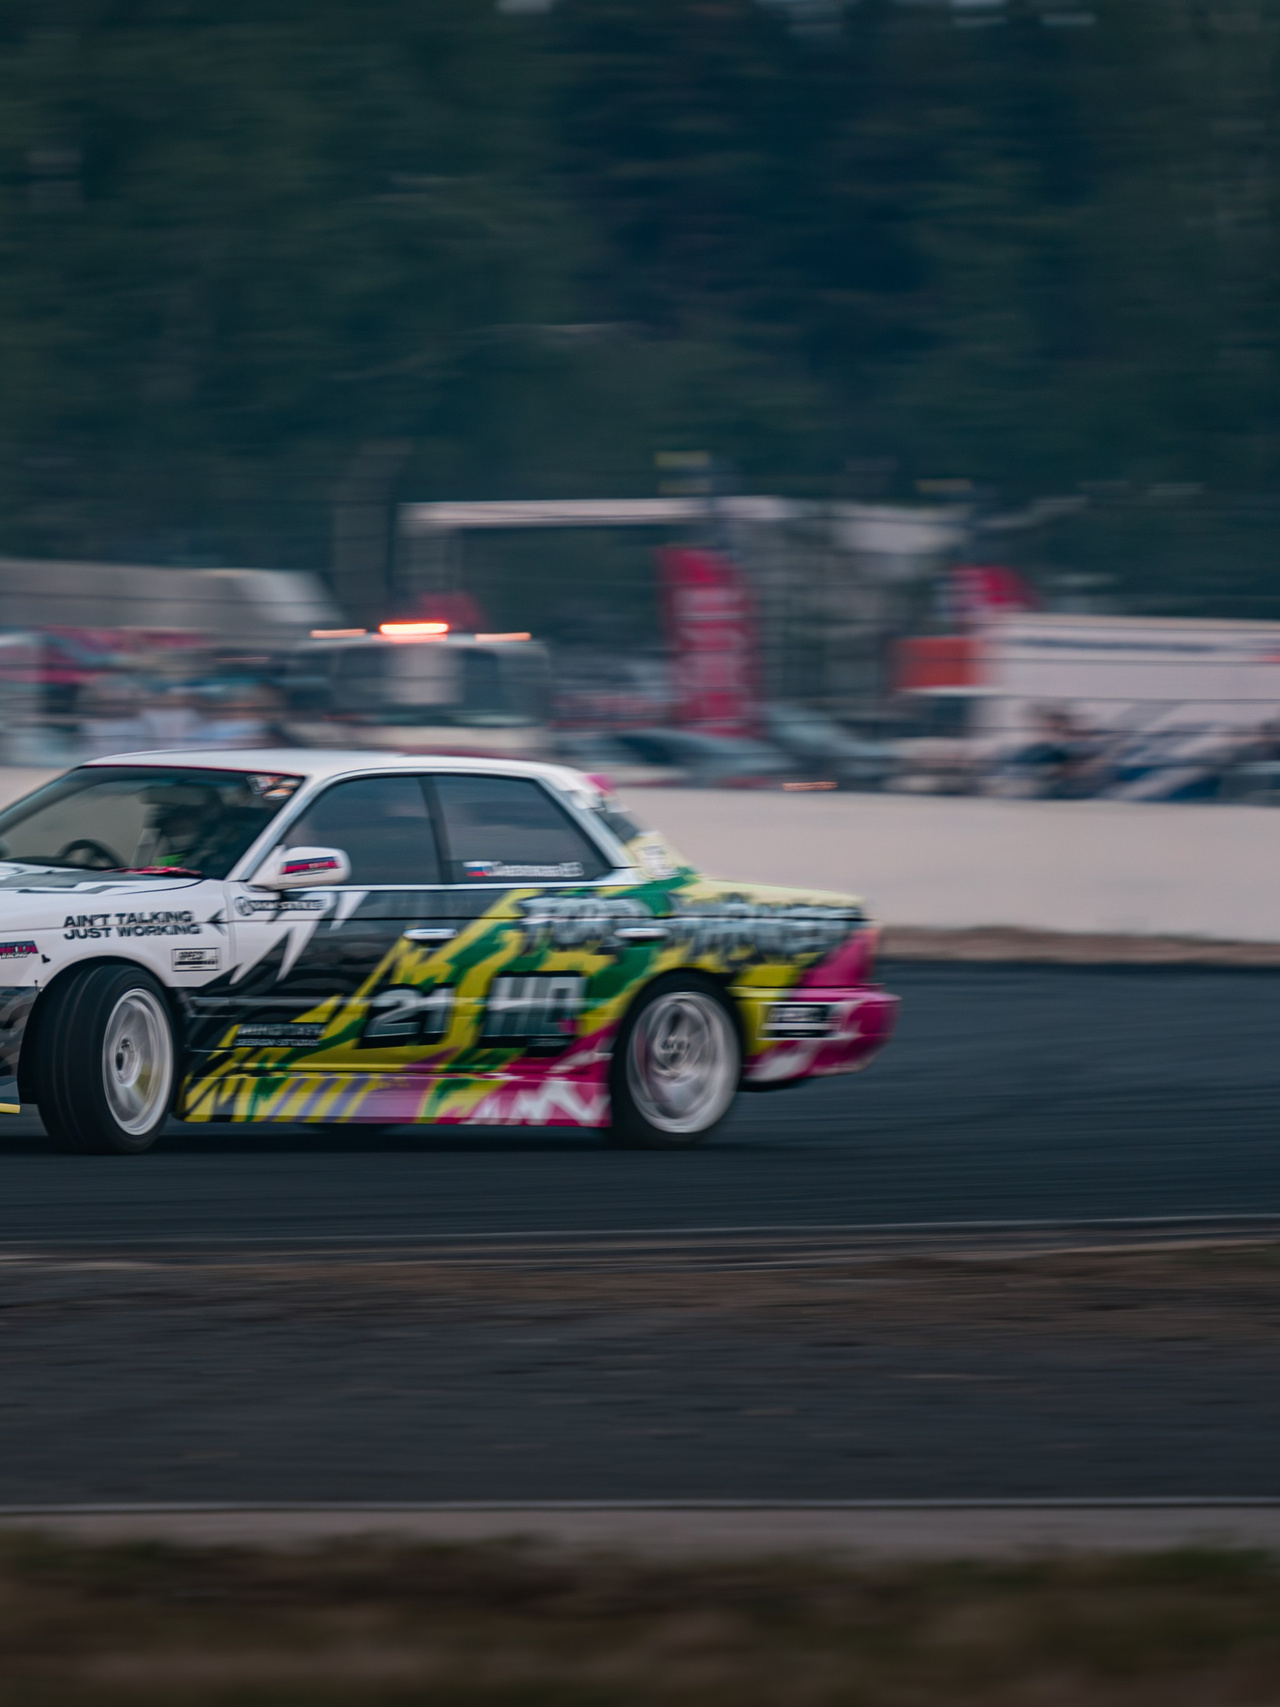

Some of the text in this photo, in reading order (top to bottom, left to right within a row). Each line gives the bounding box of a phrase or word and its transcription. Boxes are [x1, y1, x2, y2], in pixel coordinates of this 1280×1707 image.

[63, 911, 194, 928] AIN'T TALKING
[63, 923, 203, 940] JUST WORKING
[365, 988, 456, 1037] 21
